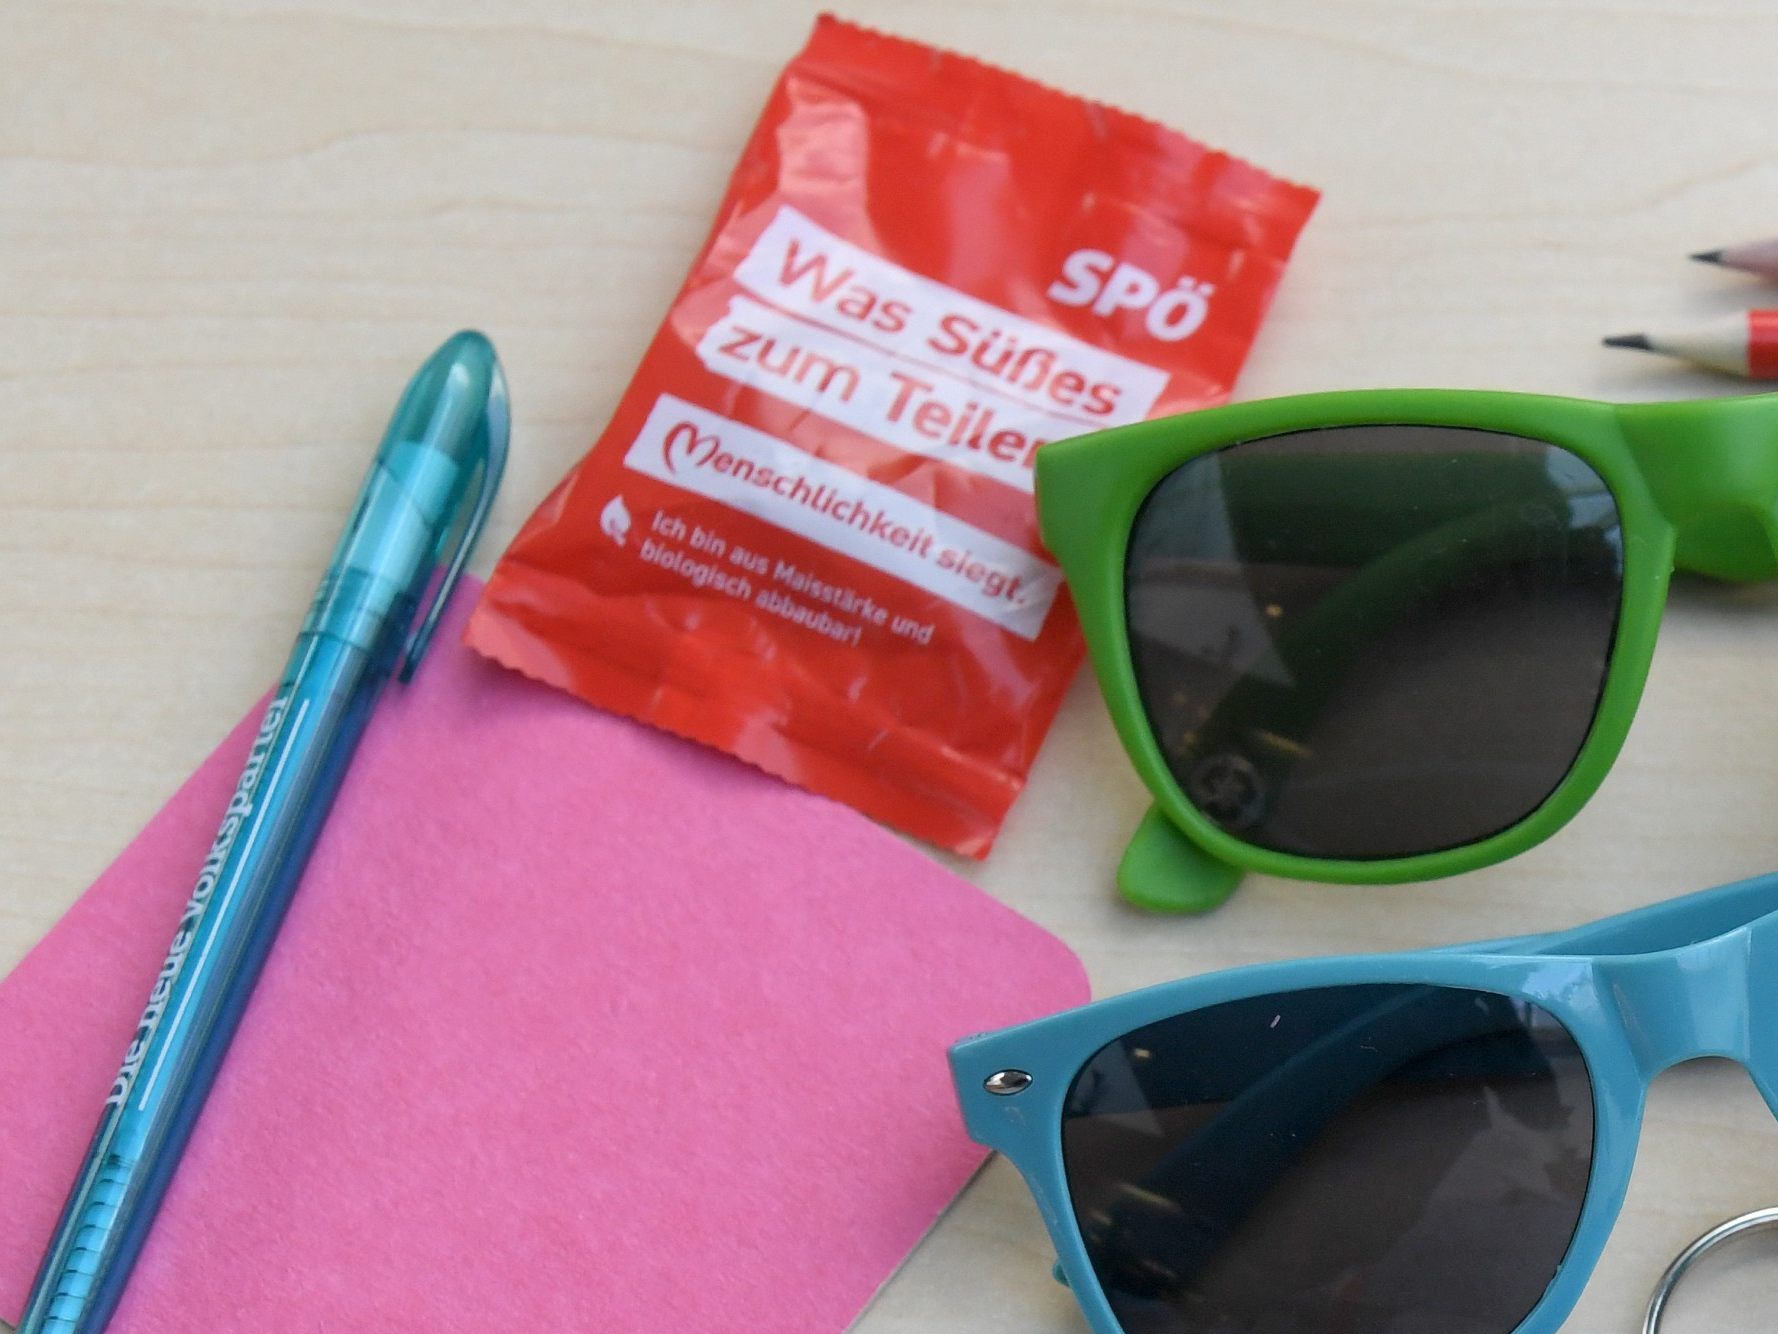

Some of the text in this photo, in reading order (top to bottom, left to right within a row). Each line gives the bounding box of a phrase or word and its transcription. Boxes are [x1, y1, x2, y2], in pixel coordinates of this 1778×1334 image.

[777, 240, 1122, 418] Was Süßes
[1047, 248, 1215, 342] SPÖ
[719, 324, 861, 403] zum
[663, 420, 1026, 605] Menschlichkeit siegt.
[640, 537, 863, 648] biologisch abbaubar!
[652, 511, 936, 646] Ich bin aus Maisstärke und
